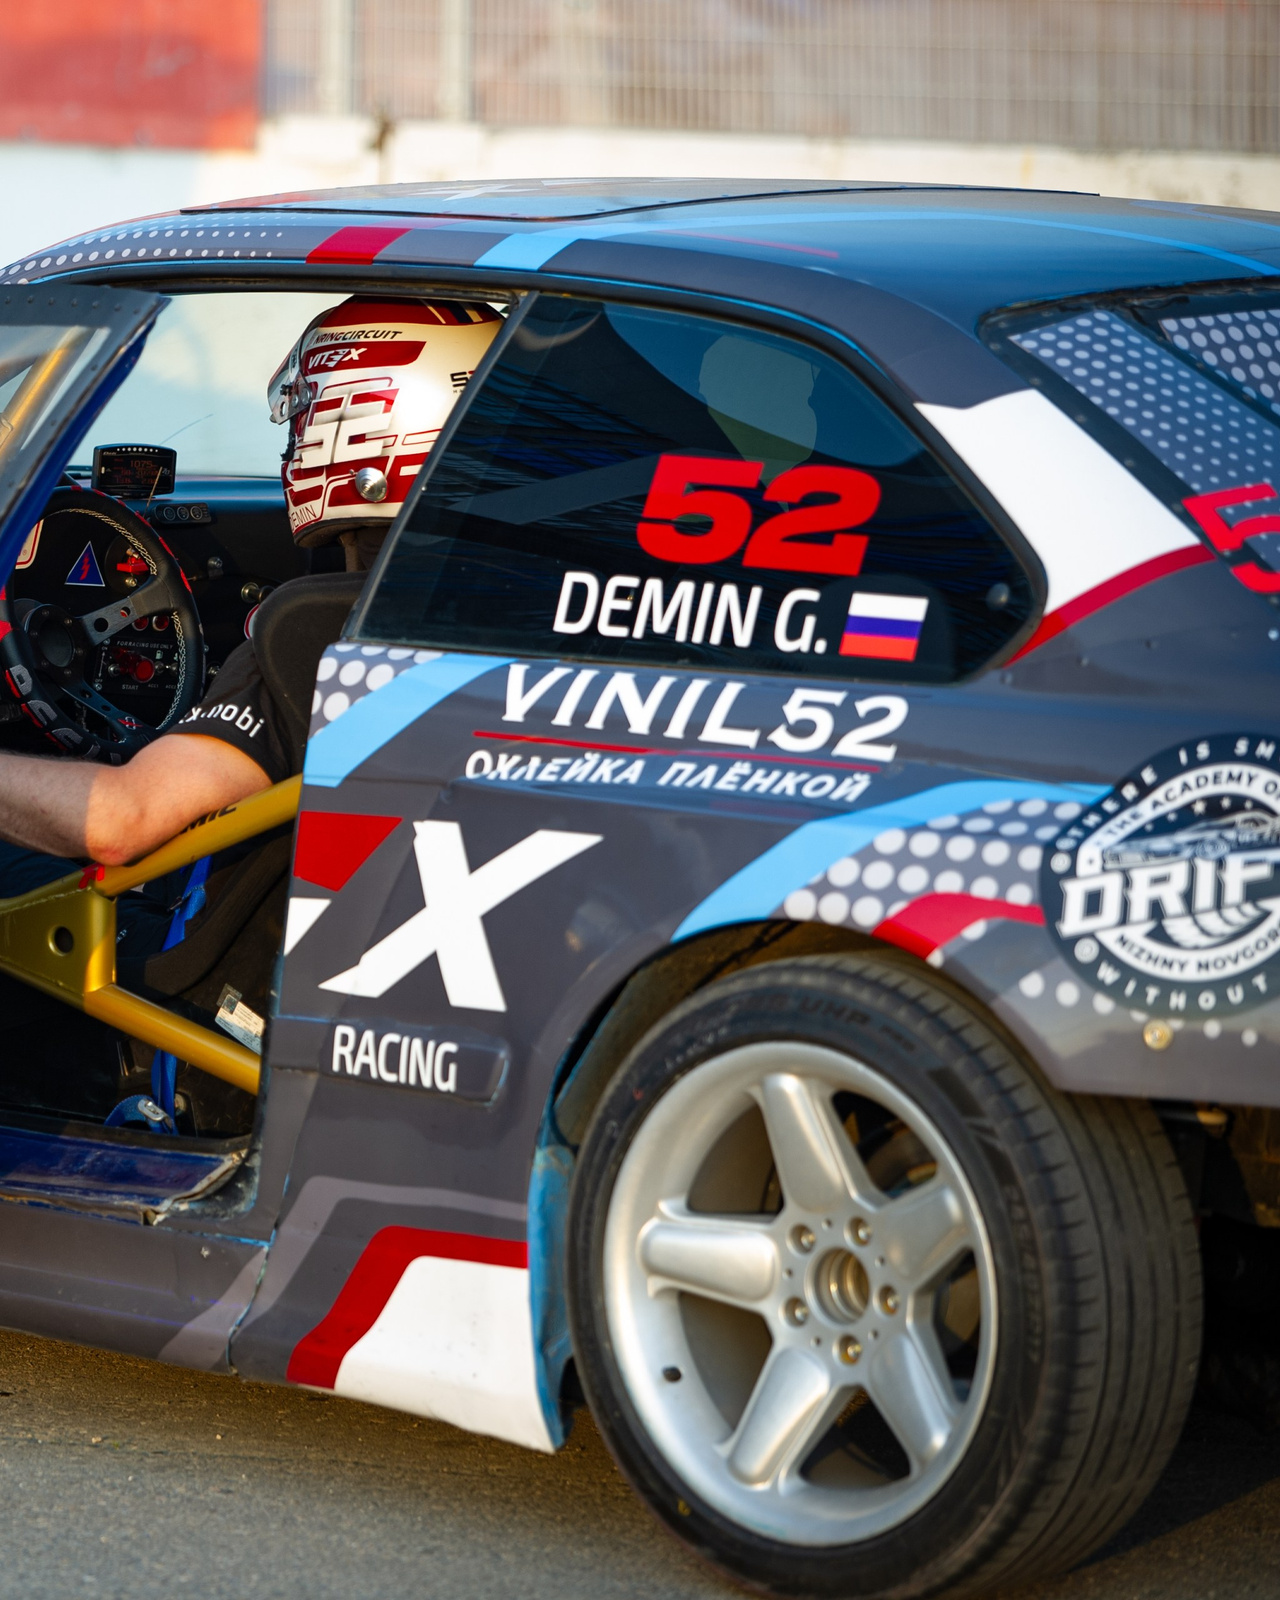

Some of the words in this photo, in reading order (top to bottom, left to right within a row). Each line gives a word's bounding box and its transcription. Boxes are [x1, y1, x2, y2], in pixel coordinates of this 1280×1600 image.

[290, 504, 317, 531] EMIN
[636, 454, 882, 576] 52
[552, 571, 763, 648] DEMIN
[773, 588, 827, 654] G.
[501, 663, 910, 763] VINIL52
[657, 761, 873, 802] ПЛЁНКОЙ
[1178, 741, 1211, 767] IS
[1104, 808, 1144, 839] THE
[1150, 770, 1259, 811] ACADEMY
[1115, 934, 1188, 973] NIZHNY
[1096, 960, 1268, 1012] WITHOUT
[331, 1024, 459, 1091] RACING
